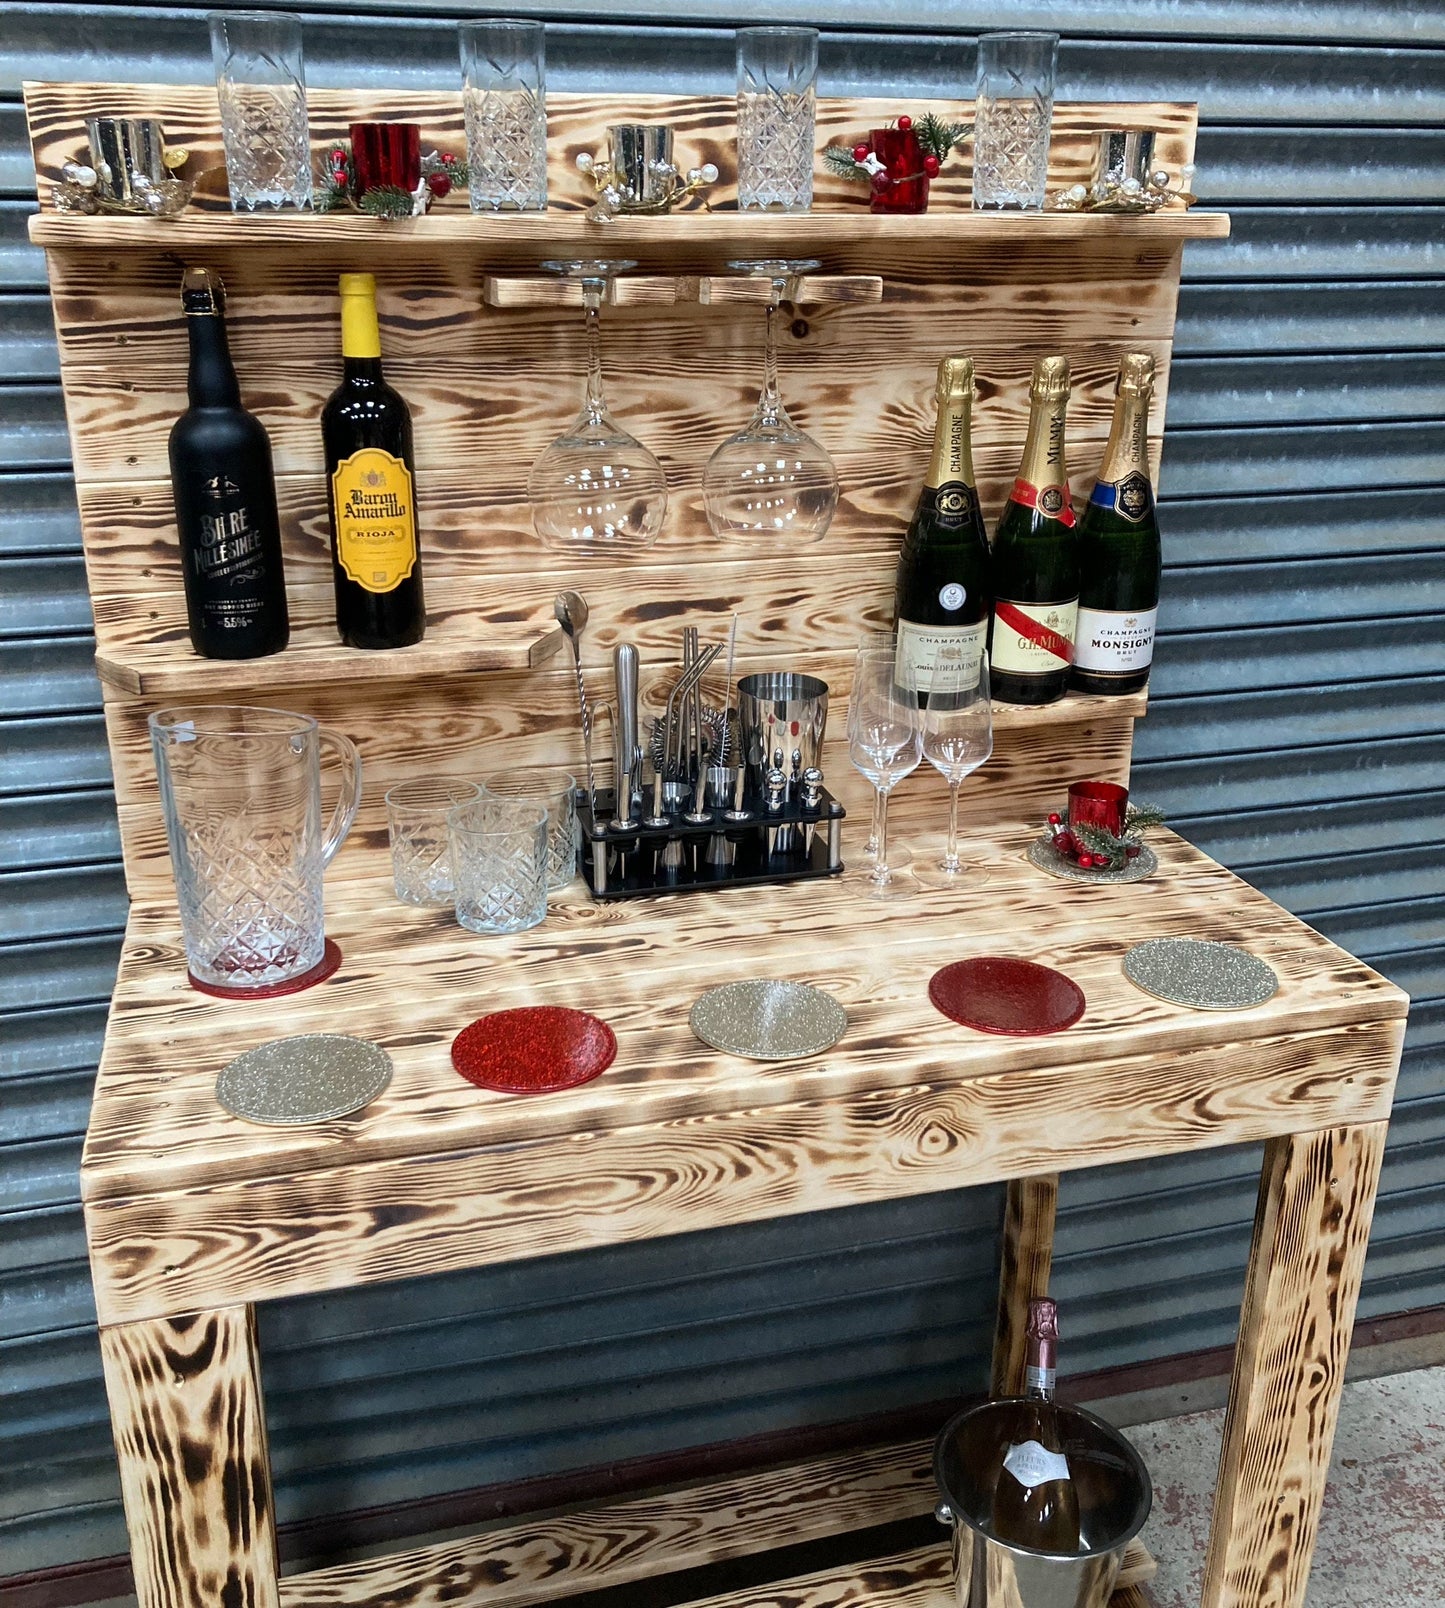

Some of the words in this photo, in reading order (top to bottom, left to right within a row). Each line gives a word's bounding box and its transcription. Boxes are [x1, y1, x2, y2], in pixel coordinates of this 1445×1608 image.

[950, 414, 963, 473] CHAMPAGNE
[1046, 415, 1063, 465] MUMM
[1131, 412, 1142, 463] CHAMPAGNE
[349, 489, 398, 505] Baron
[343, 502, 406, 519] Amarillo
[1100, 626, 1151, 636] CHAMPAGNE
[919, 635, 978, 644] CHAMPAGNE
[1091, 635, 1153, 649] MONSIGNY
